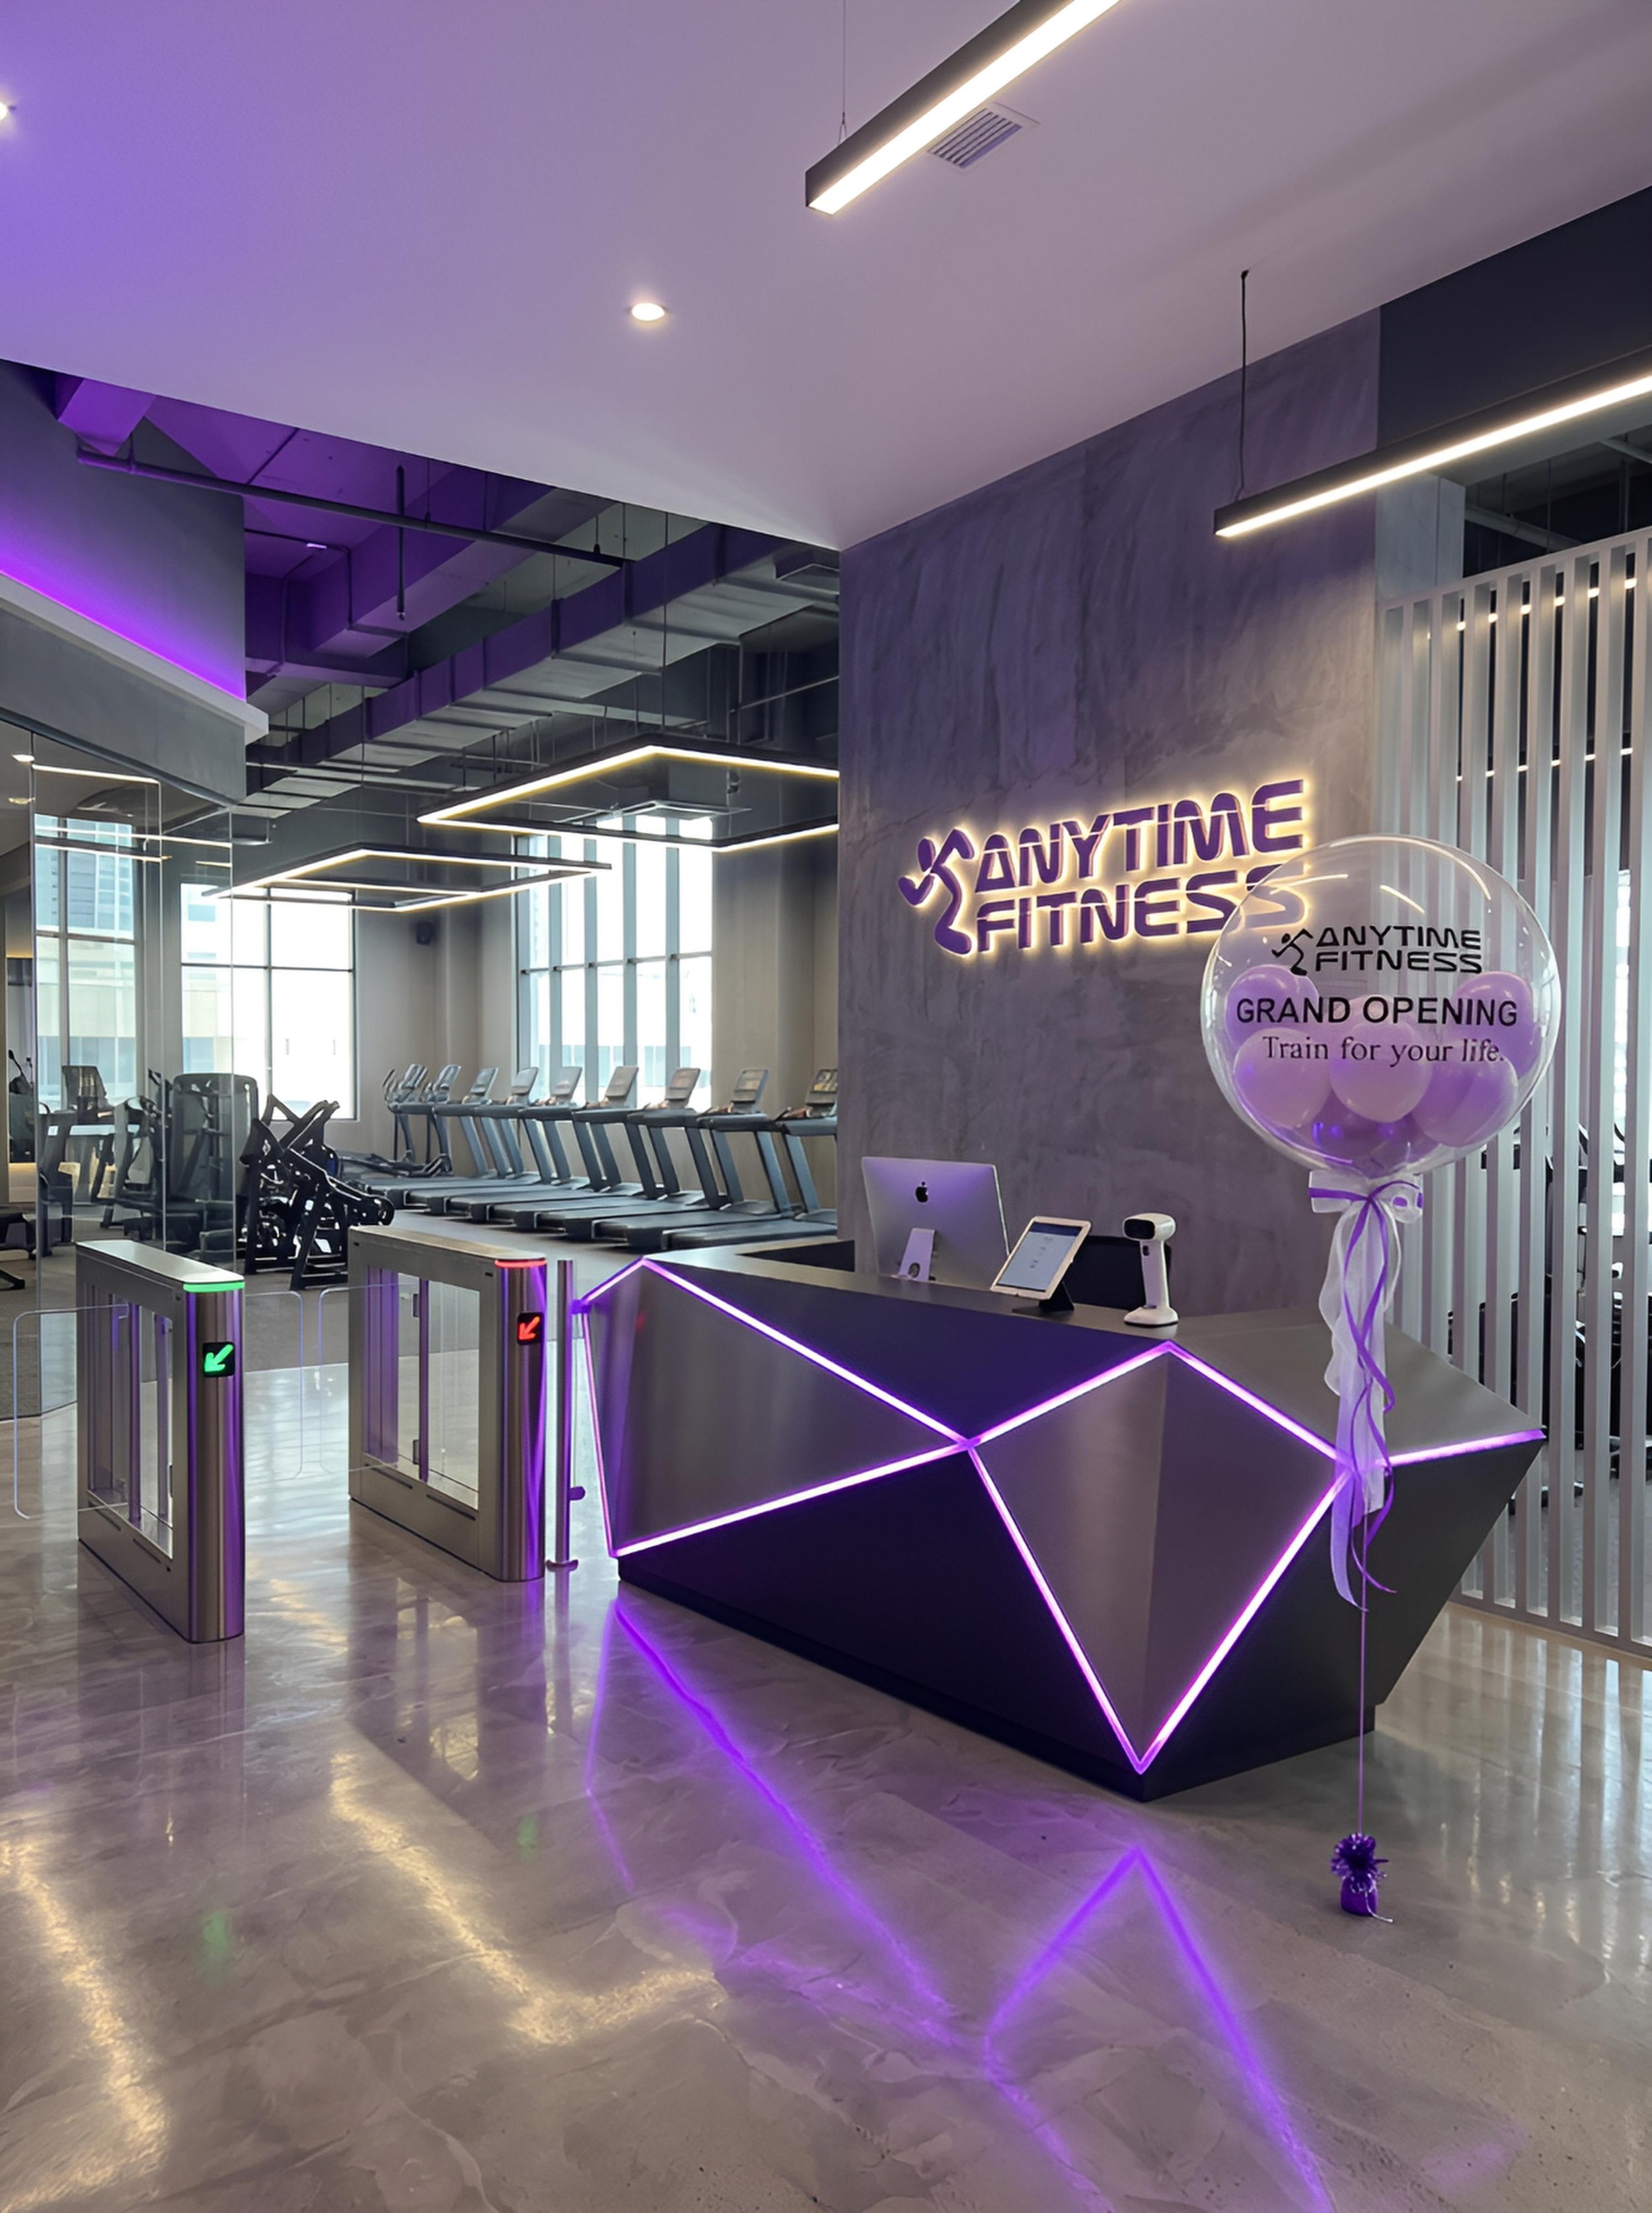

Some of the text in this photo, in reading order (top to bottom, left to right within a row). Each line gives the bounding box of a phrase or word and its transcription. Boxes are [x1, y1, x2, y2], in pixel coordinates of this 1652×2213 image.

[975, 779, 1304, 892] ANYTIME
[977, 864, 1306, 953] FITNESS
[1316, 925, 1482, 950] ANYTIME
[1315, 950, 1483, 974] FITNESS
[1236, 996, 1518, 1027] GRAND OPENING
[1262, 1036, 1329, 1060] Train
[1341, 1036, 1381, 1061] for
[1390, 1042, 1454, 1068] your
